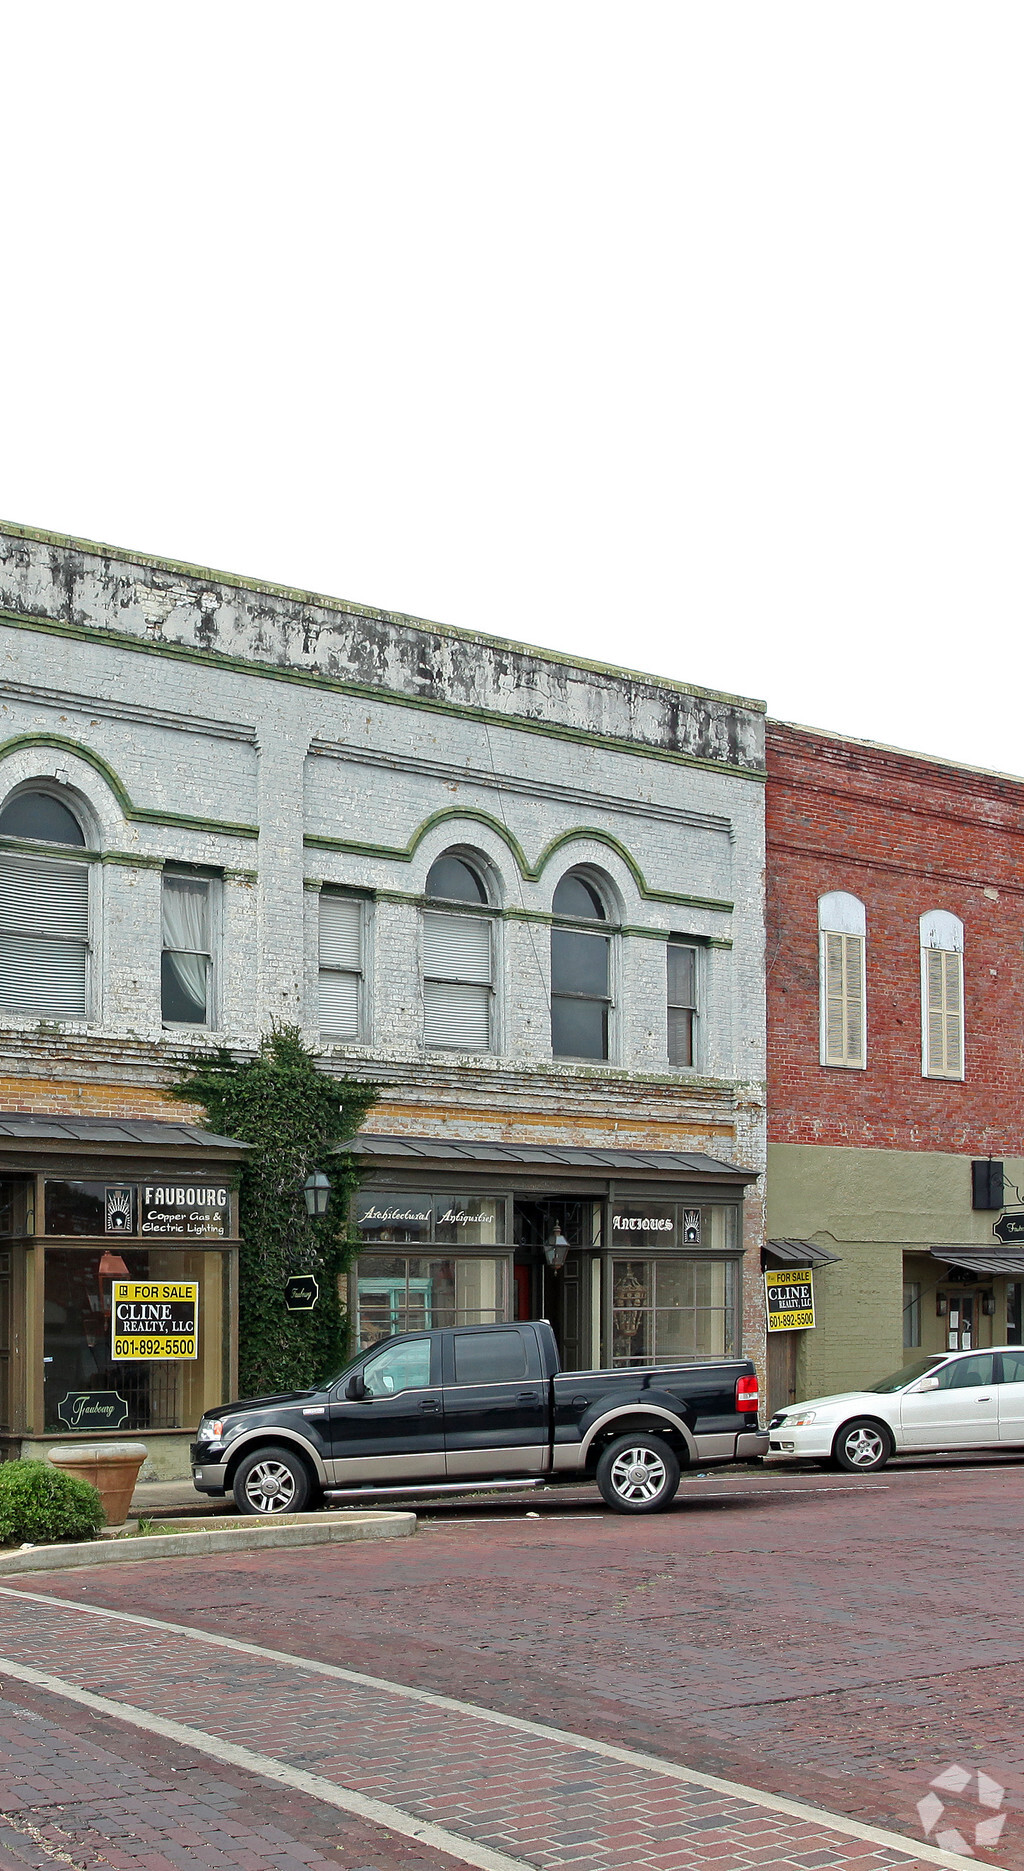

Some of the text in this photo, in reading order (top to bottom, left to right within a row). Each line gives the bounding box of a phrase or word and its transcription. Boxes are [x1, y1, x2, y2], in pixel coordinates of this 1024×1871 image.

[145, 1187, 227, 1206] FAUBOURG
[147, 1210, 222, 1222] Copper Gas &
[357, 1205, 494, 1226] Architectural Antiquities
[142, 1222, 224, 1235] Electric Lighting
[777, 1272, 809, 1282] FOR SALE
[134, 1286, 193, 1298] FOR SALE
[768, 1286, 809, 1300] CLINE
[779, 1298, 811, 1308] REALTY, LLC
[116, 1303, 172, 1320] CLINE
[122, 1320, 194, 1334] REALTY, LLC
[769, 1313, 813, 1327] 601-892-5500
[115, 1339, 195, 1355] 601-892-5500
